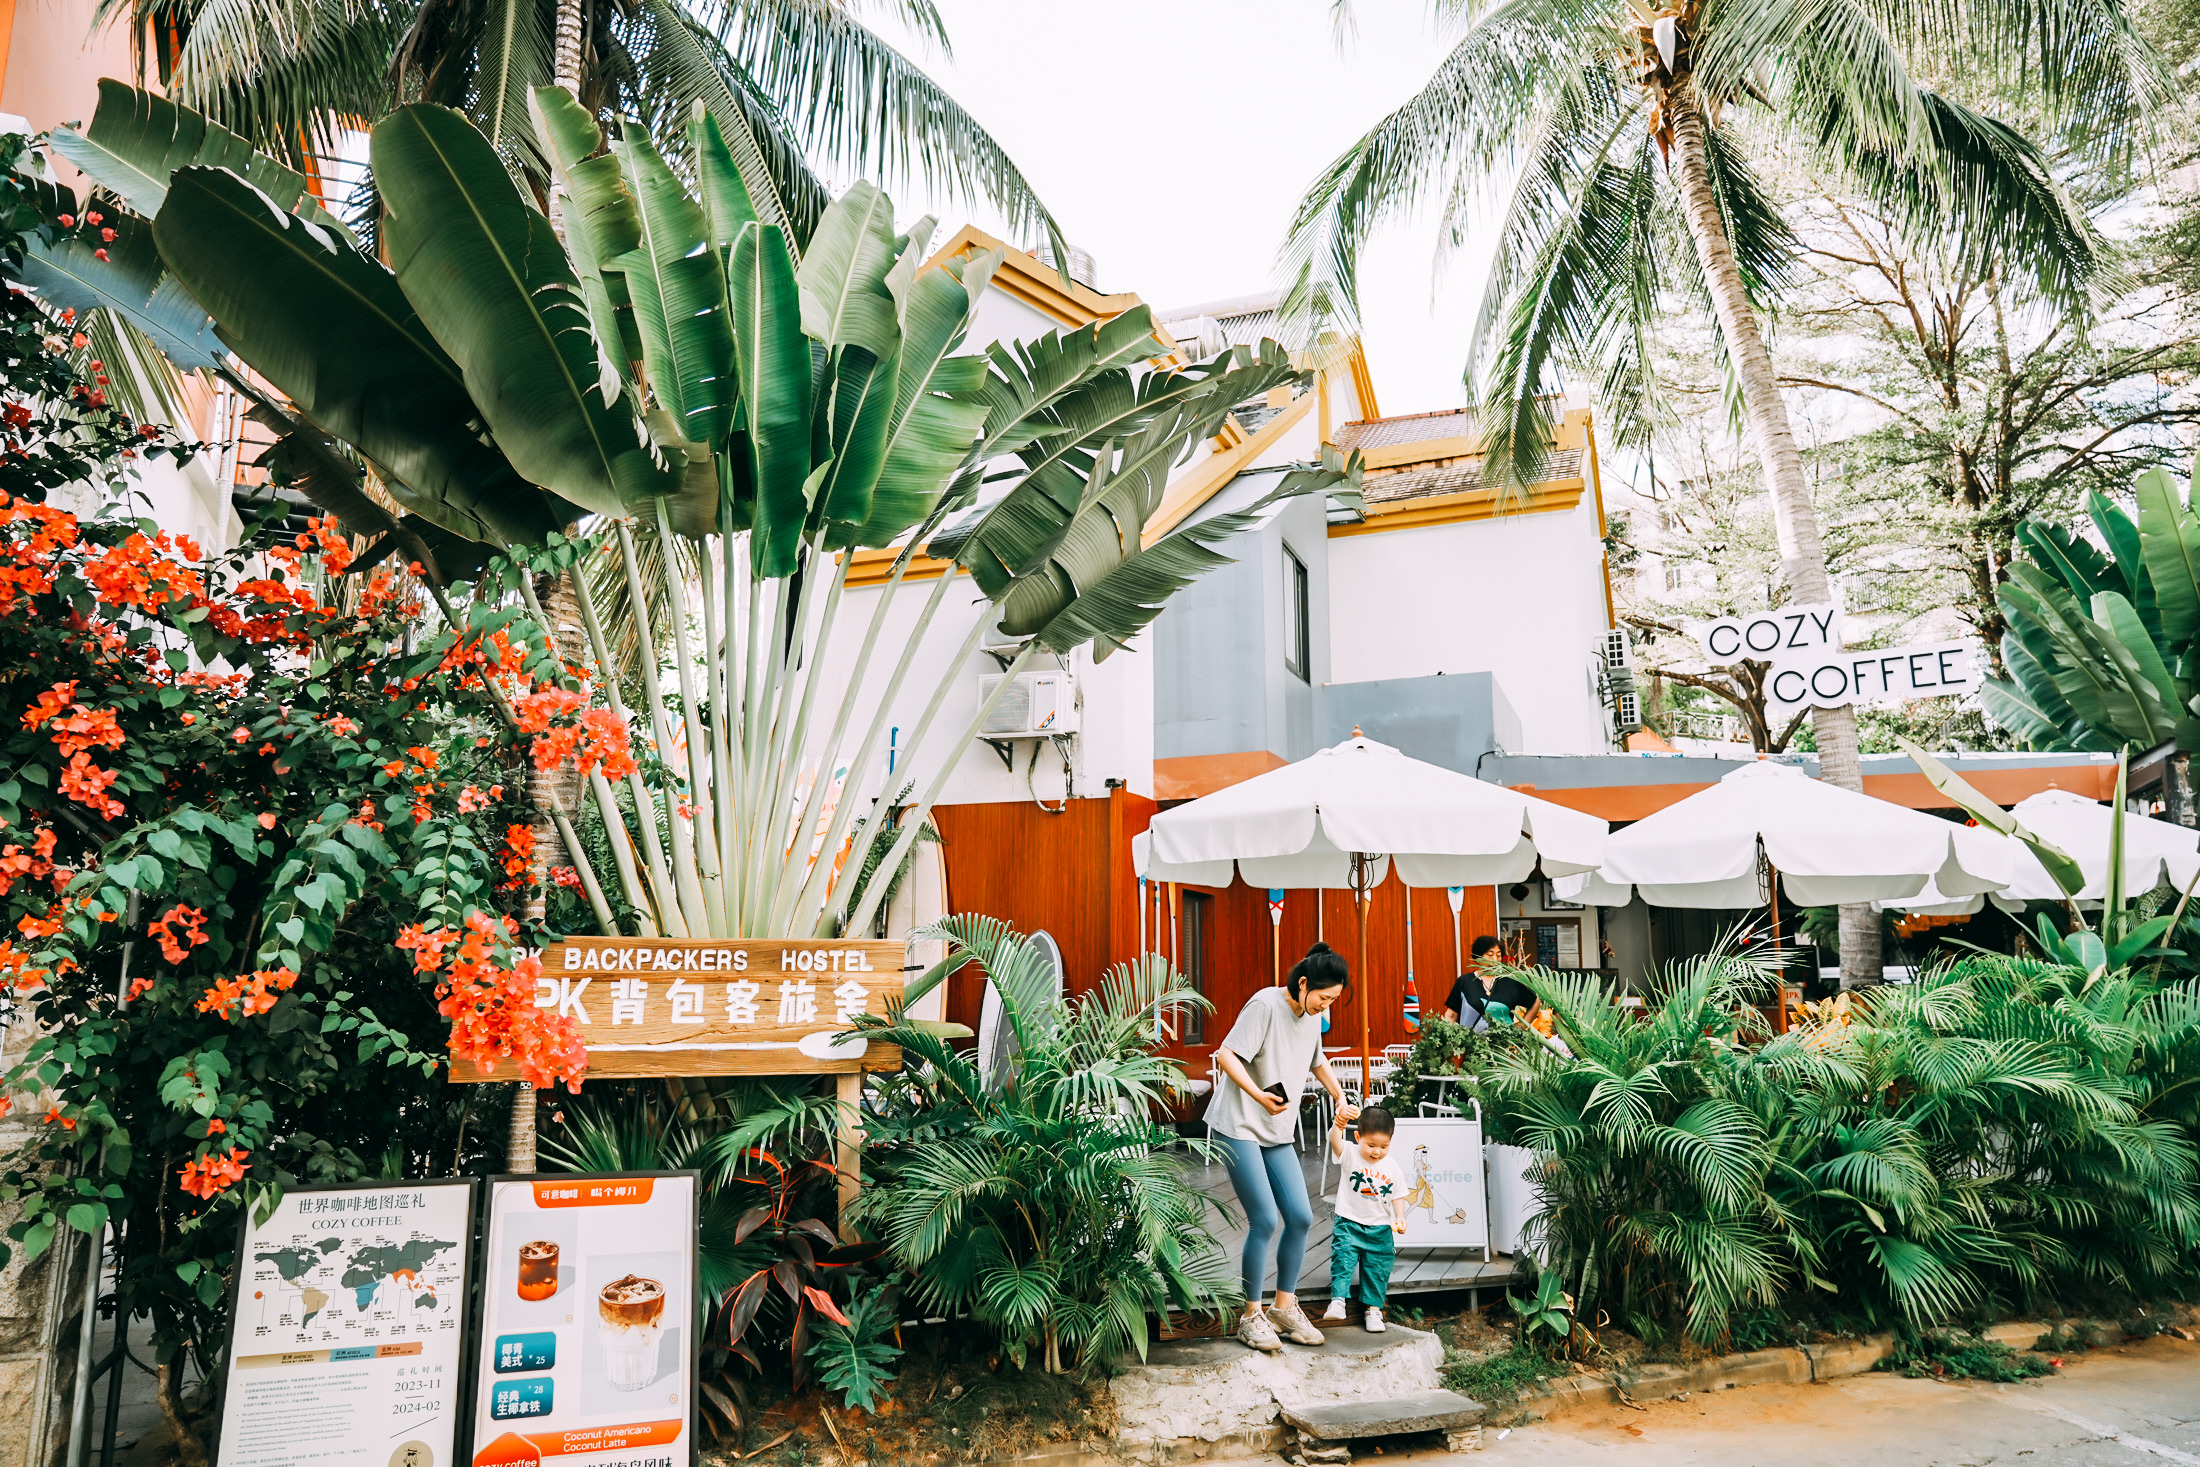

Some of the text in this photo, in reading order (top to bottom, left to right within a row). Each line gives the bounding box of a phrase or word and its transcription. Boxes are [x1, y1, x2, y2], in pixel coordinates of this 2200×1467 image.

[1709, 609, 1834, 656] COZY
[1773, 648, 1967, 703] COFFEE
[564, 947, 748, 971] BACKPACKERS
[781, 948, 874, 971] HOSTEL
[610, 977, 870, 1025] 背包客旅舍
[1425, 1169, 1473, 1183] coffee
[541, 1189, 579, 1200] 可意咖啡
[298, 1193, 426, 1214] 世界咖啡地图巡礼
[312, 1216, 403, 1230] COZY COFFEE
[501, 1342, 523, 1356] 椰青
[500, 1354, 523, 1368] 美式
[535, 1356, 546, 1365] 25
[394, 1378, 441, 1392] 2023-11
[534, 1385, 544, 1394] 28
[497, 1390, 520, 1404] 经典
[392, 1400, 441, 1415] 2024-02
[496, 1400, 541, 1416] 生椰拿铁
[563, 1426, 652, 1442] Coconut Americano
[563, 1438, 627, 1452] Coconut Latte
